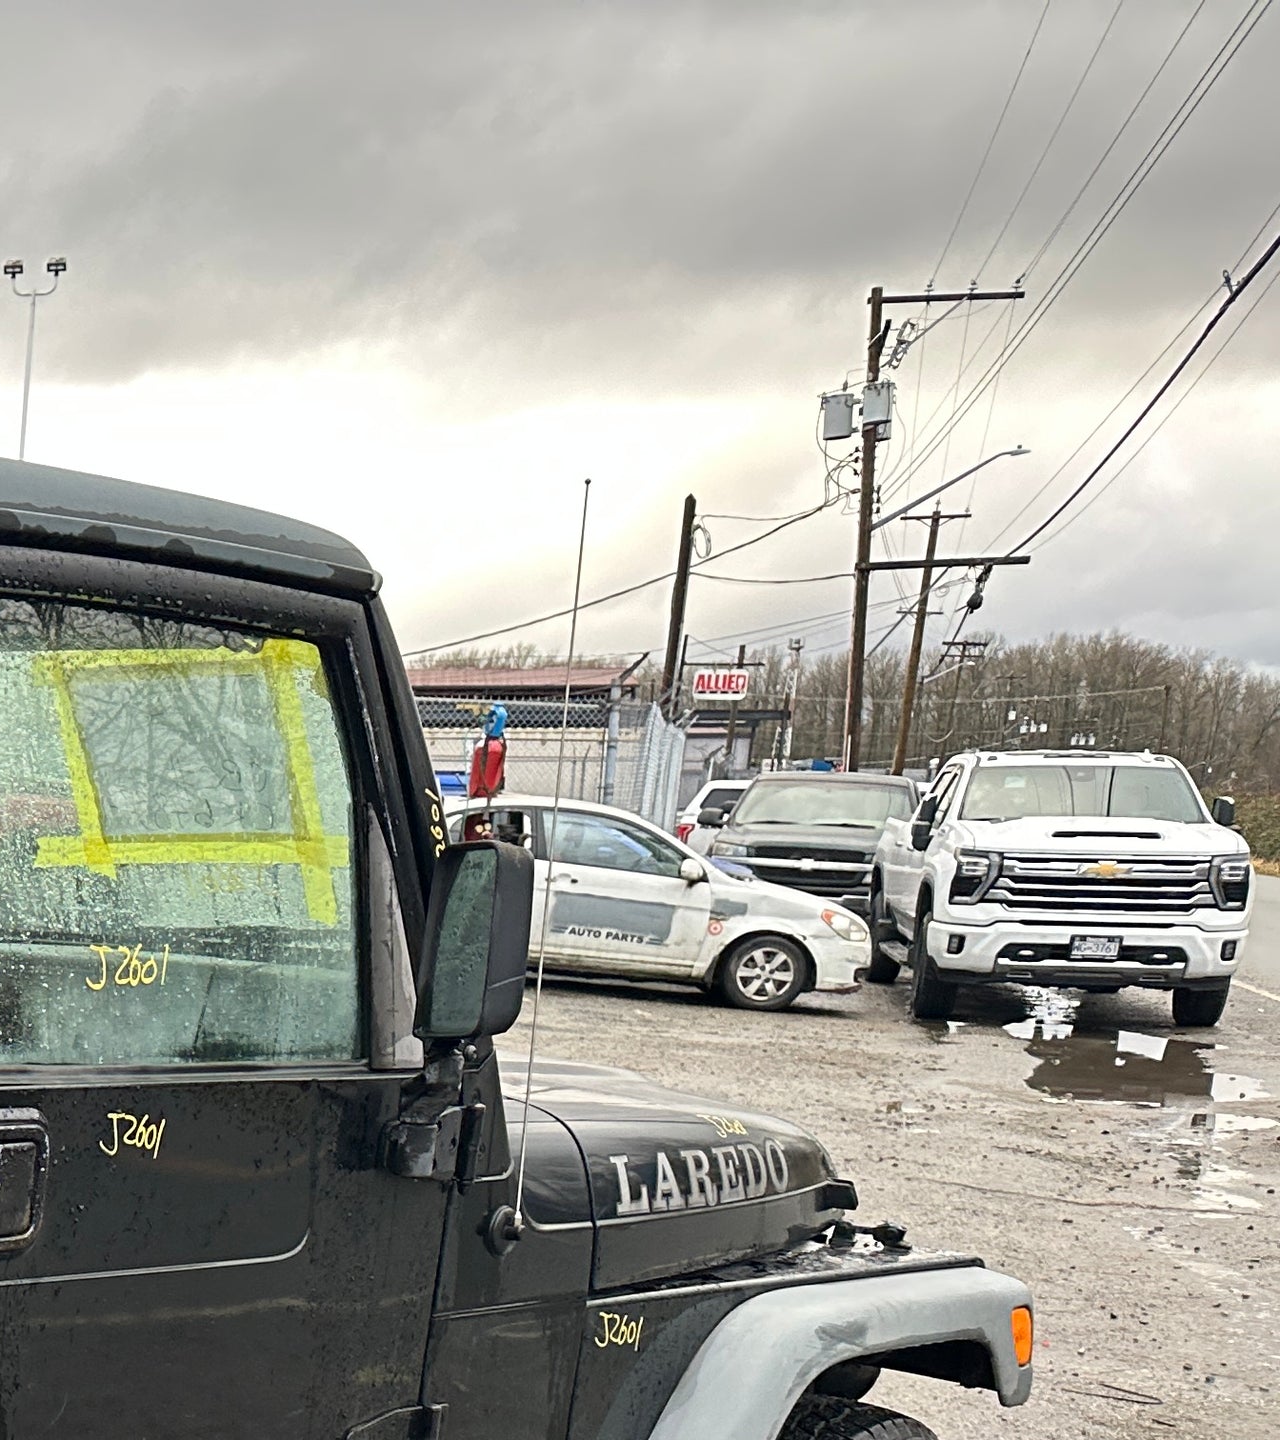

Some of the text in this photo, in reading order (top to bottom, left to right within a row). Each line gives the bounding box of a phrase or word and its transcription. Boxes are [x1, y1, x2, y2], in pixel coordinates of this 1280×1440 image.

[694, 673, 747, 691] ALLIED
[568, 926, 645, 945] AUTO PARTS
[85, 942, 171, 991] J2601
[98, 1112, 167, 1160] J2601
[609, 1137, 791, 1217] LAREDO
[594, 1311, 645, 1352] J2601
